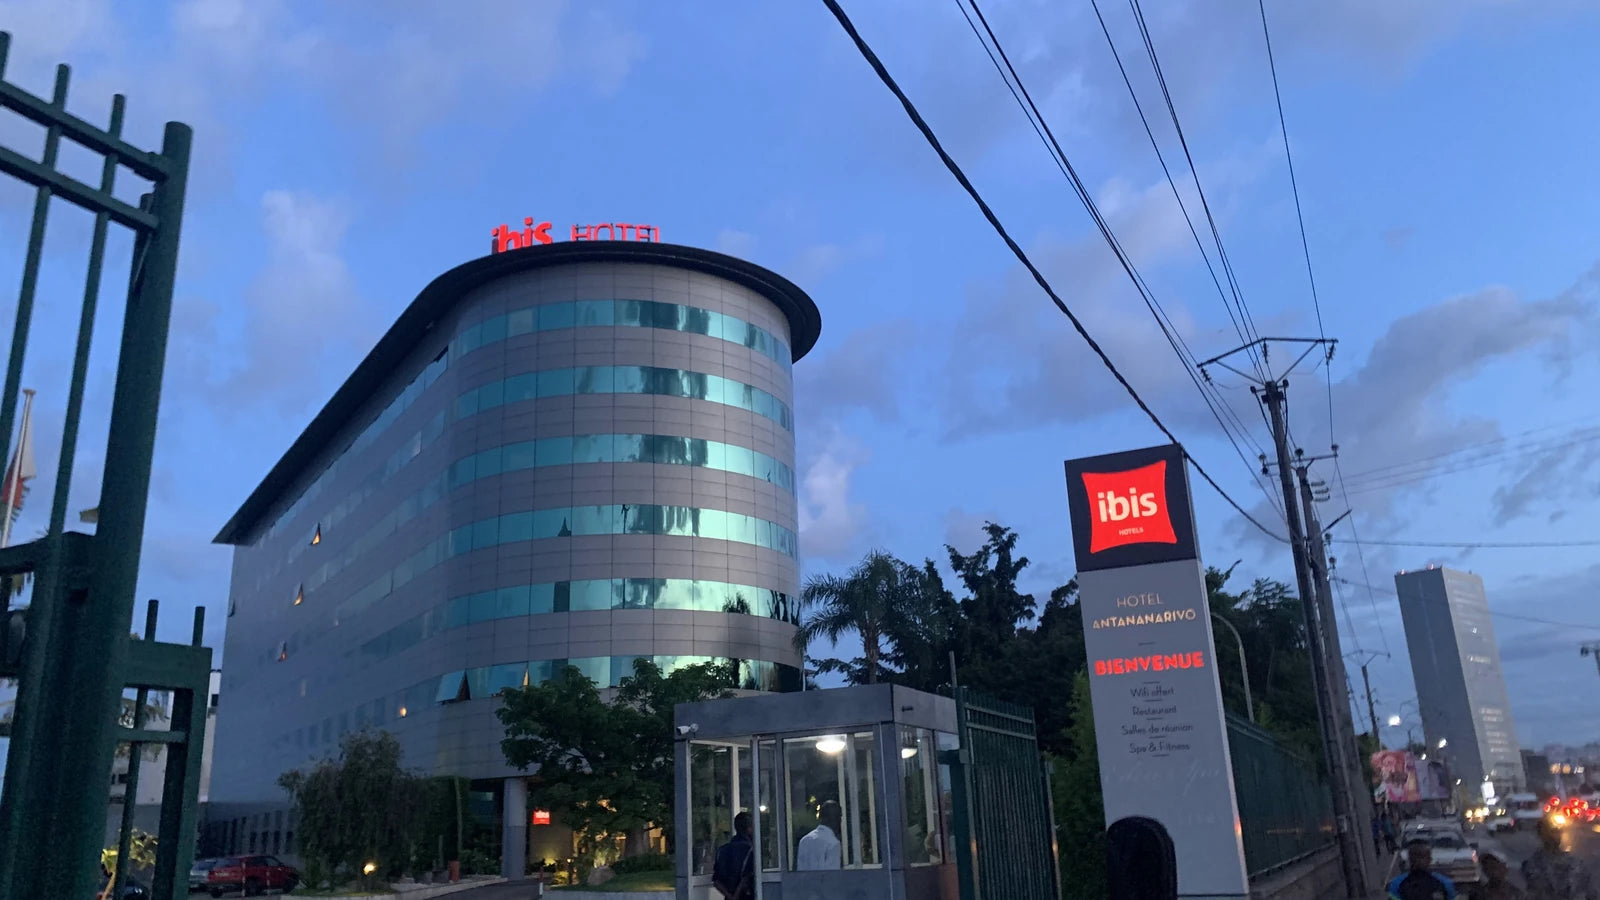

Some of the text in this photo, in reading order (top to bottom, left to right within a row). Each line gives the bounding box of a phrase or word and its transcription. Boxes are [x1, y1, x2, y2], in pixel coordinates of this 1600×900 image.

[1097, 487, 1158, 523] ibis
[1118, 526, 1144, 537] HOTELS
[1116, 592, 1163, 608] HOTEL
[1092, 608, 1196, 629] ANTANANARIVO
[1094, 651, 1204, 676] BIENVENUE
[1132, 704, 1177, 716] Restaurant
[1121, 724, 1146, 736] Salles
[1148, 723, 1159, 734] de
[1129, 740, 1191, 755] Spa & Fitness
